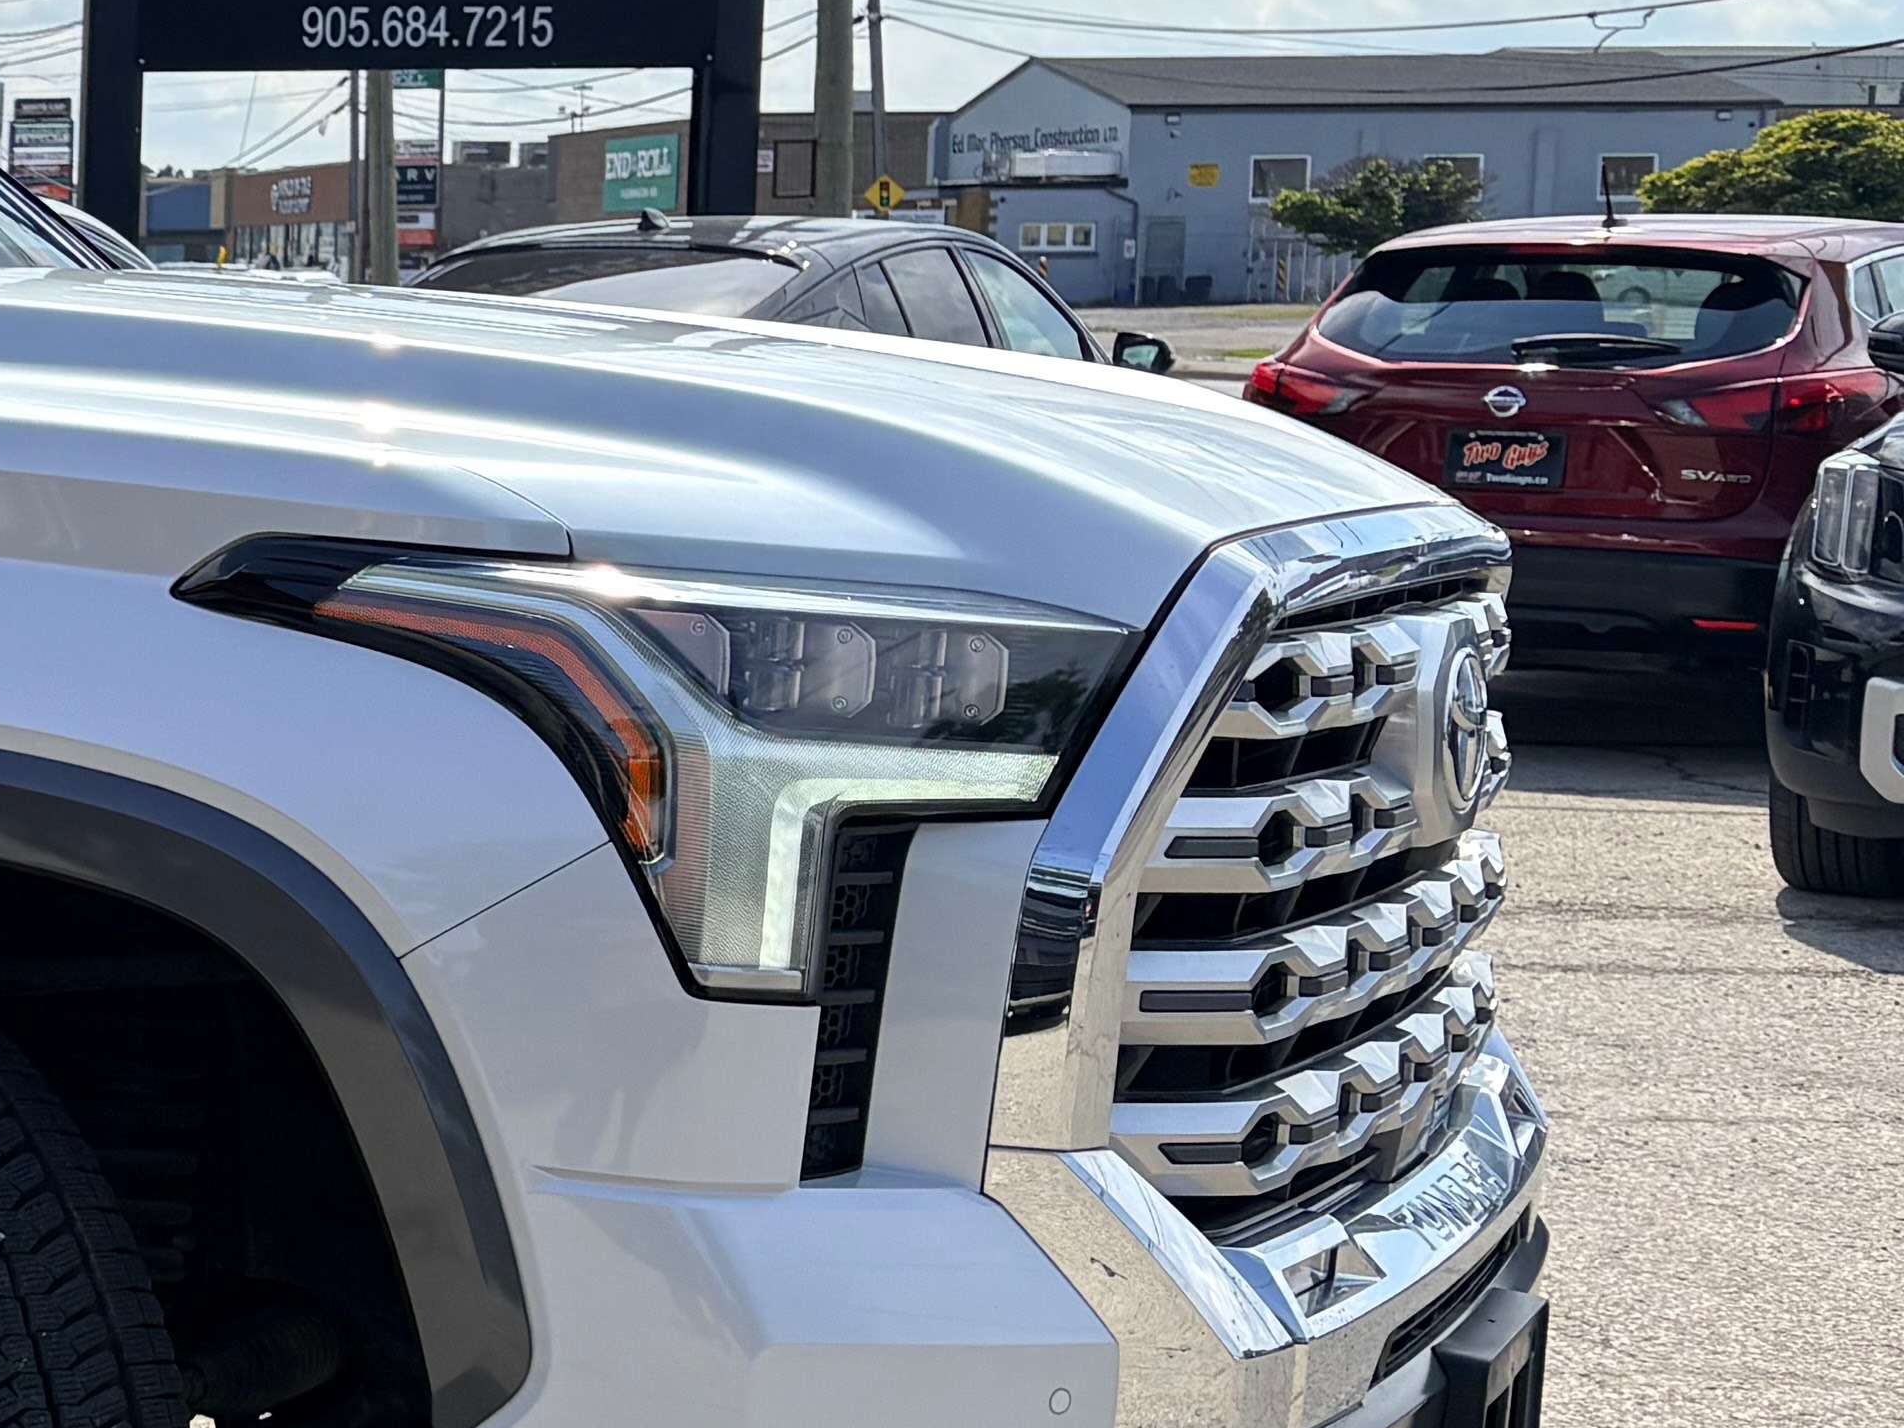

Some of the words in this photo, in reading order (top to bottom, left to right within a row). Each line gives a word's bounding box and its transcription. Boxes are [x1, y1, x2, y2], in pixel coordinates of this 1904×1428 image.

[302, 5, 554, 48] 905.684.7215
[1034, 124, 1100, 149] Construction
[605, 152, 632, 181] END
[637, 147, 672, 178] ROLL
[1463, 441, 1502, 467] Two
[1502, 440, 1549, 470] Guys
[1680, 469, 1716, 481] SV
